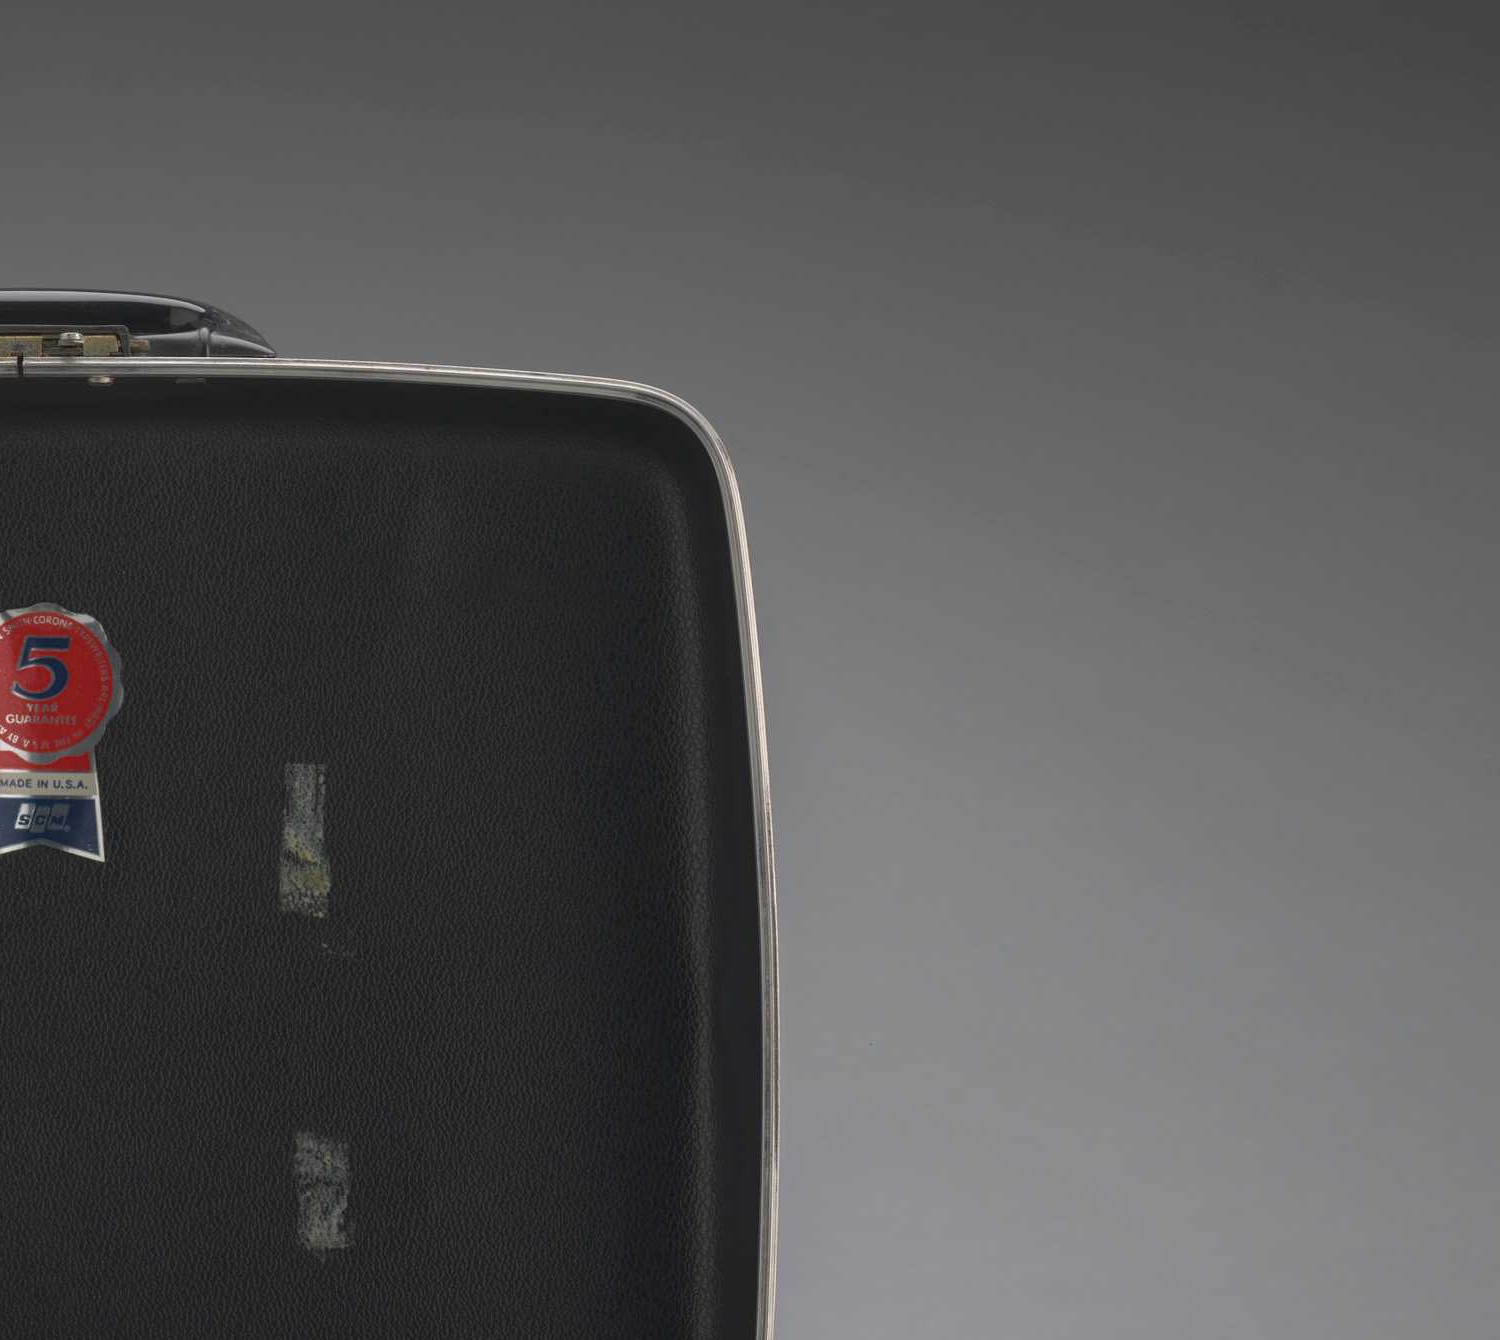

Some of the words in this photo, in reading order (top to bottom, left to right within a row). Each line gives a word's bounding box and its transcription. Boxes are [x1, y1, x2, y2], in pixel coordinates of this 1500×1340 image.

[11, 636, 71, 700] 5
[0, 778, 32, 790] MADE
[37, 779, 49, 790] IN
[52, 779, 88, 790] U.S.A.
